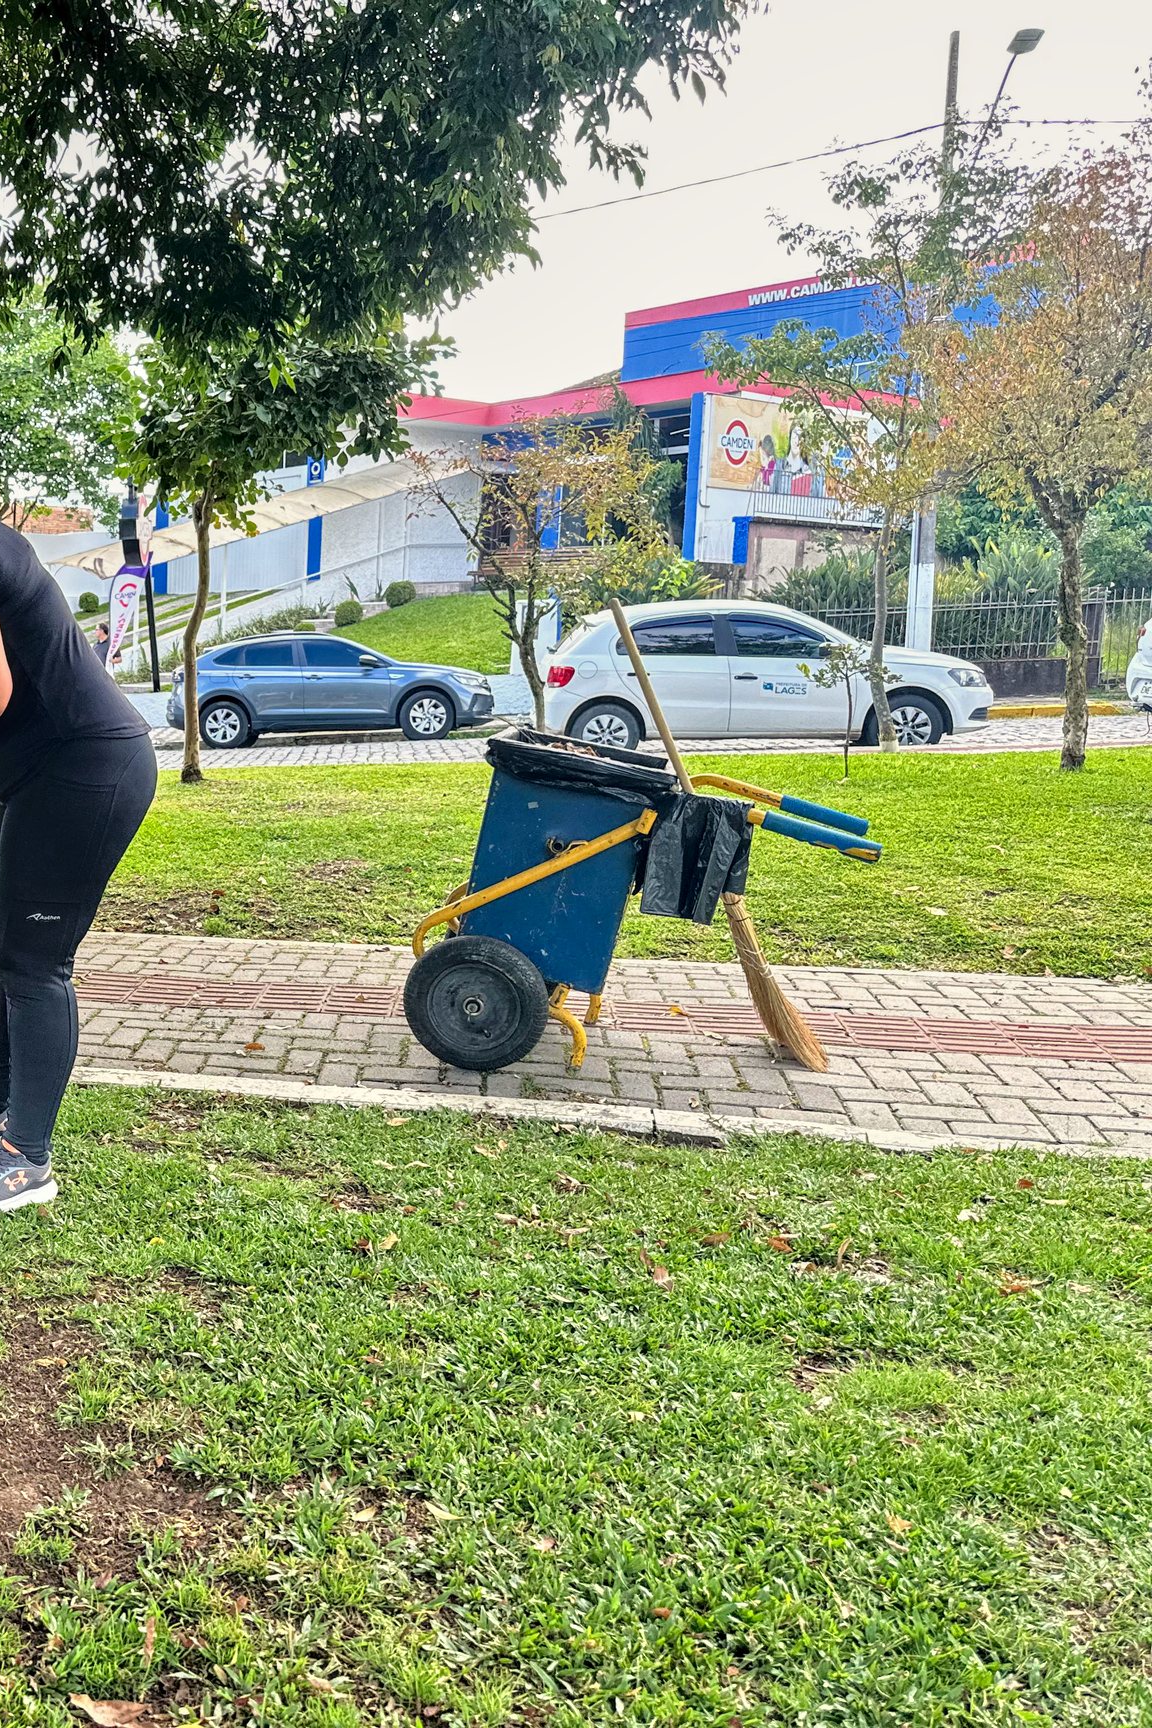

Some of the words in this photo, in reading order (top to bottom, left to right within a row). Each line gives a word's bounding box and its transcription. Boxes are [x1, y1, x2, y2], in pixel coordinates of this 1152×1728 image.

[748, 274, 882, 306] WWW.CAMDN.CO
[720, 435, 754, 450] CAMDEN
[774, 686, 807, 695] LAGES
